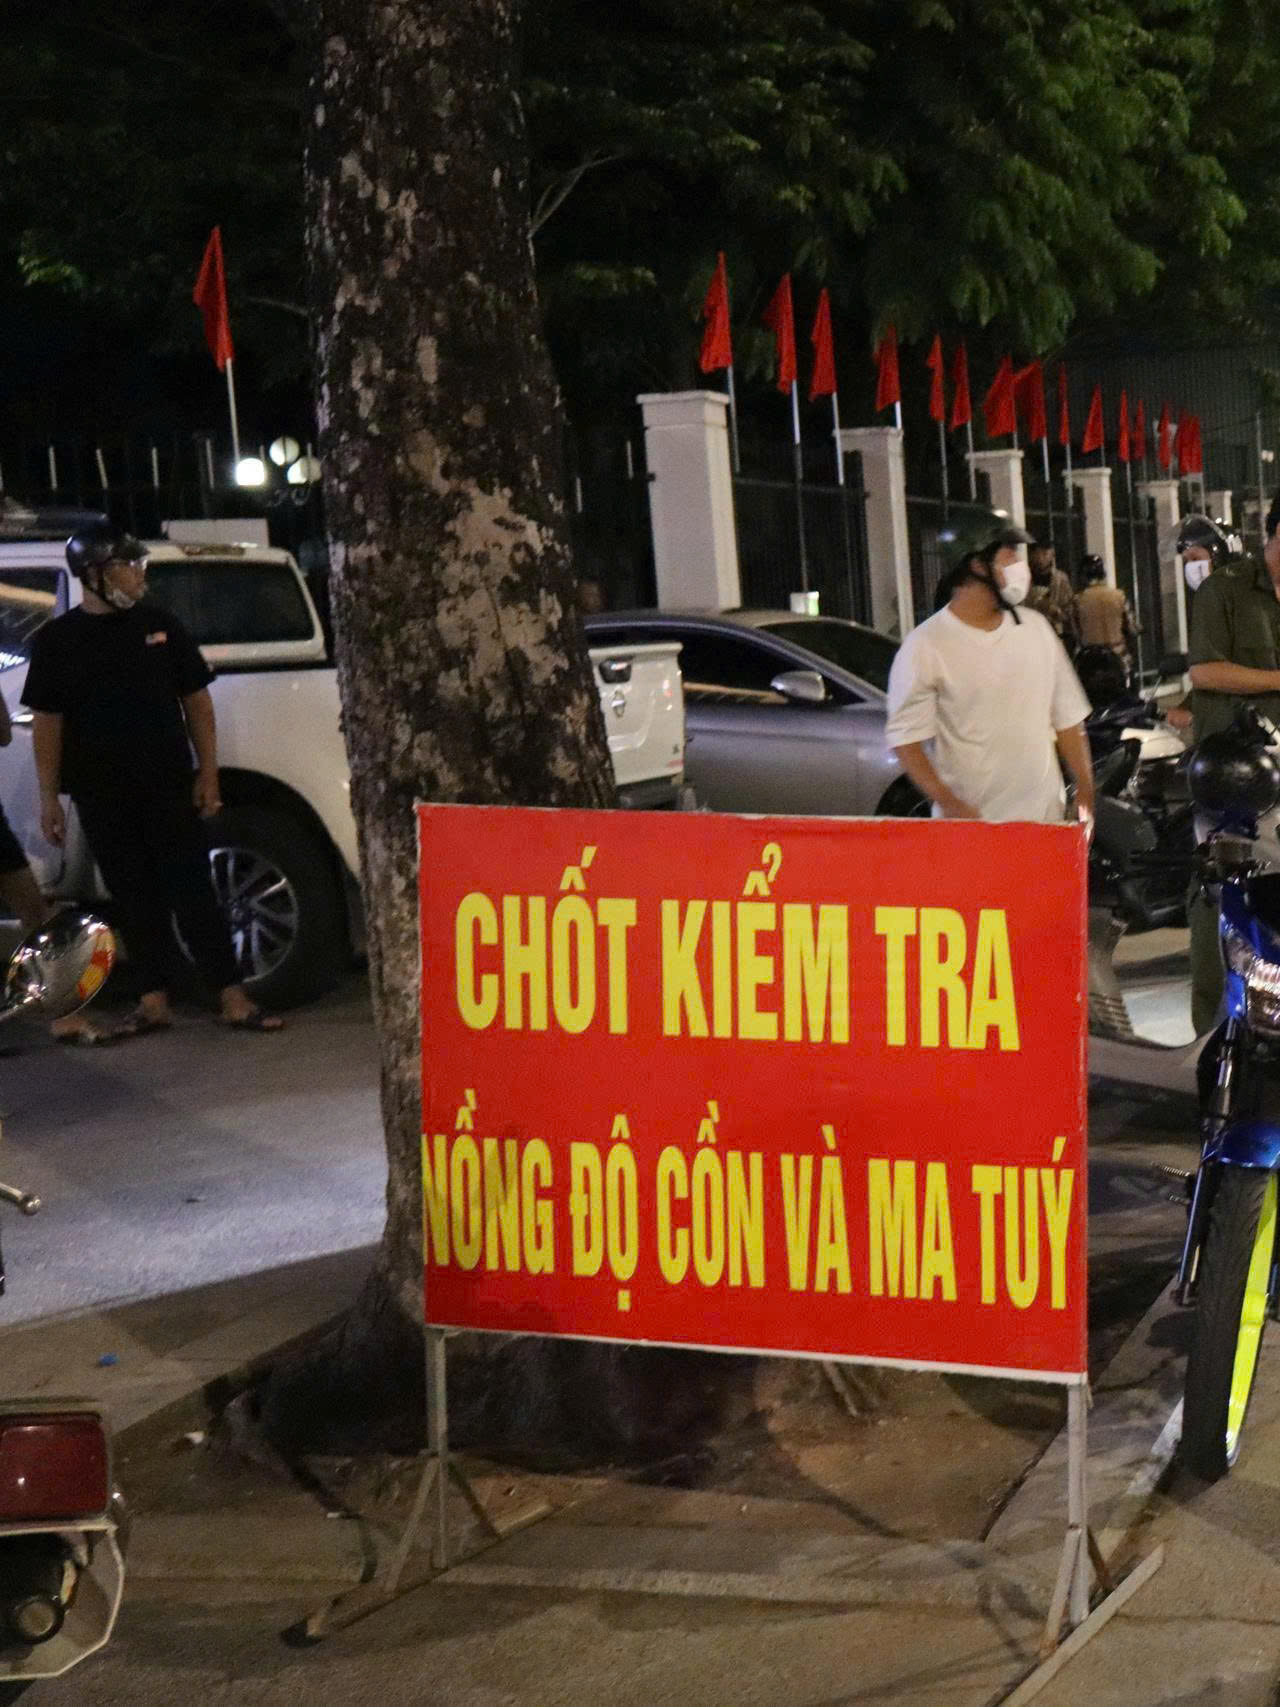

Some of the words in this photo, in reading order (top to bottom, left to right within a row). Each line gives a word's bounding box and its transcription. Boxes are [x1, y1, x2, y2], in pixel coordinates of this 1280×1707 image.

[456, 846, 636, 1034] CHỐT
[662, 843, 849, 1043] KIỂM
[875, 906, 1019, 1050] TRA
[422, 1089, 554, 1273] NỒNG
[570, 1115, 638, 1310] ĐỘ
[657, 1101, 764, 1287] CỒN
[781, 1125, 851, 1293] VÀ
[869, 1159, 957, 1300] MA
[972, 1137, 1074, 1309] TUÝ
